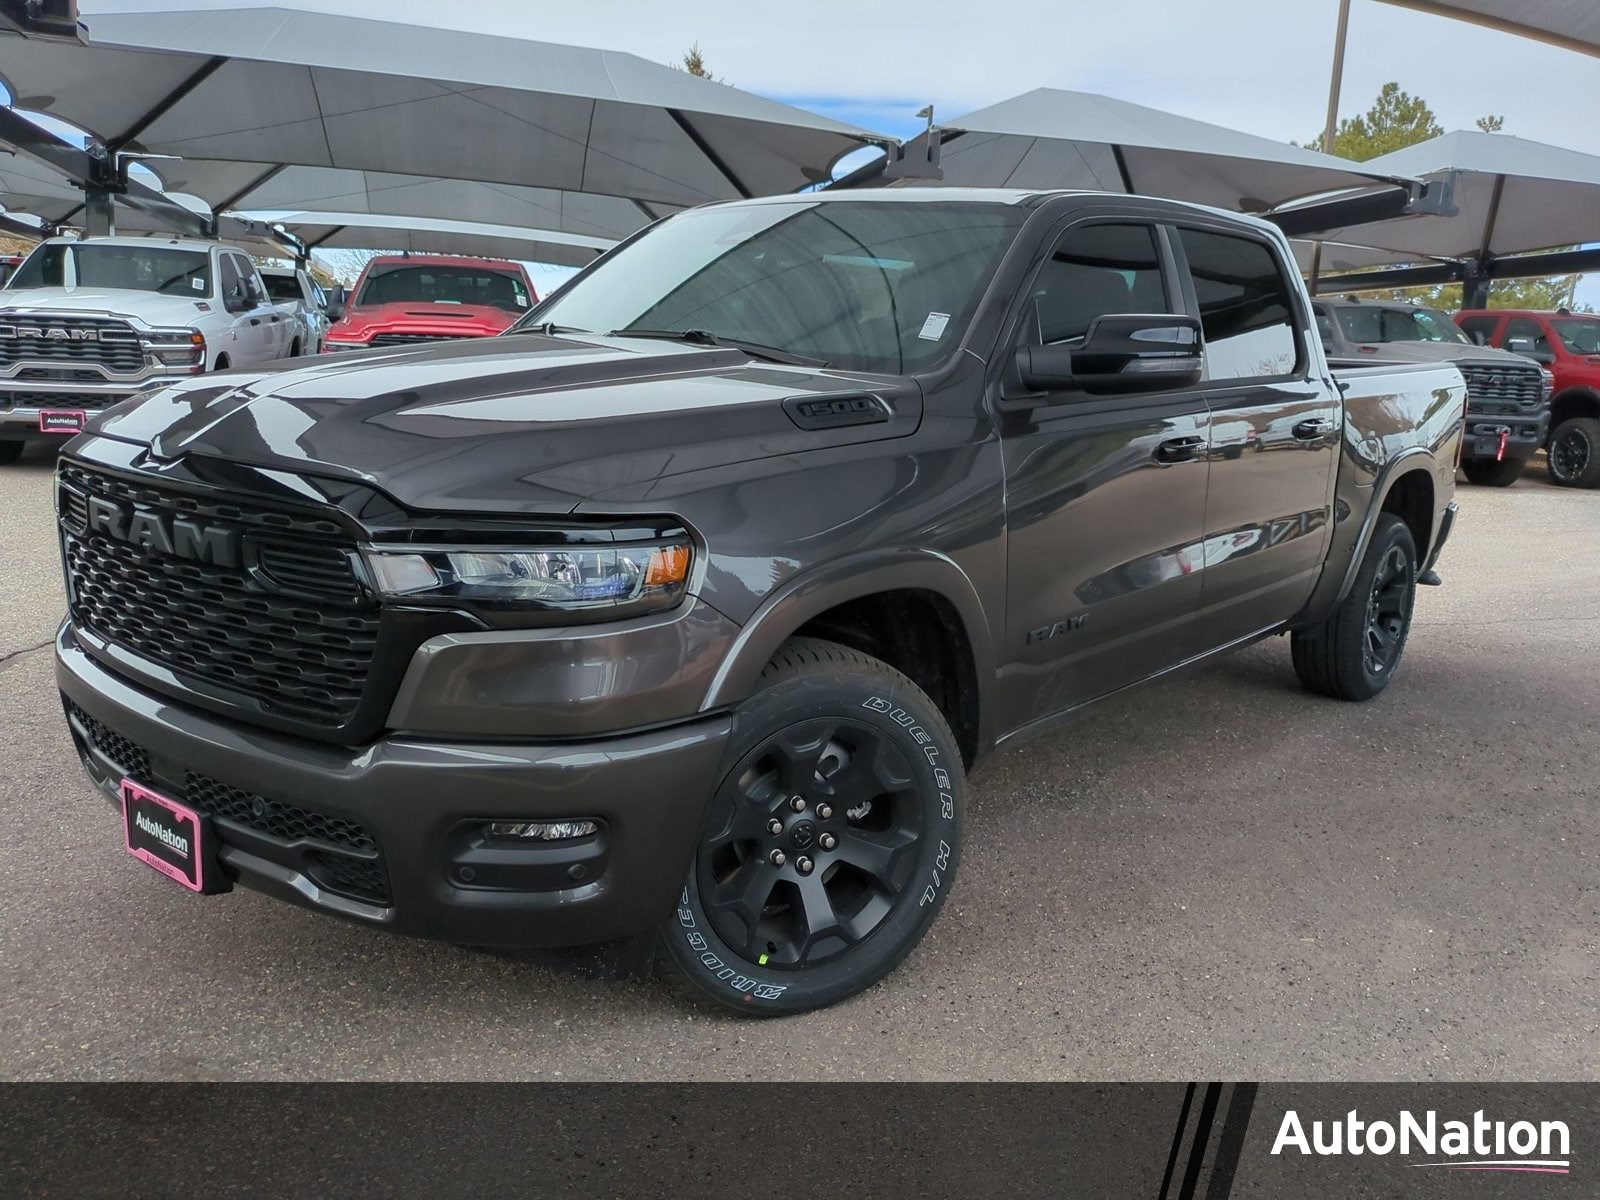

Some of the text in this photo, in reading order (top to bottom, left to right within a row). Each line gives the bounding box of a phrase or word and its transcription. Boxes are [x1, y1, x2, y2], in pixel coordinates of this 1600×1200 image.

[17, 327, 98, 341] RAM
[47, 417, 78, 426] AutoNation
[798, 399, 872, 417] 1500
[88, 494, 235, 568] RAM
[862, 696, 954, 820] DUELER
[136, 811, 188, 852] AutoNation
